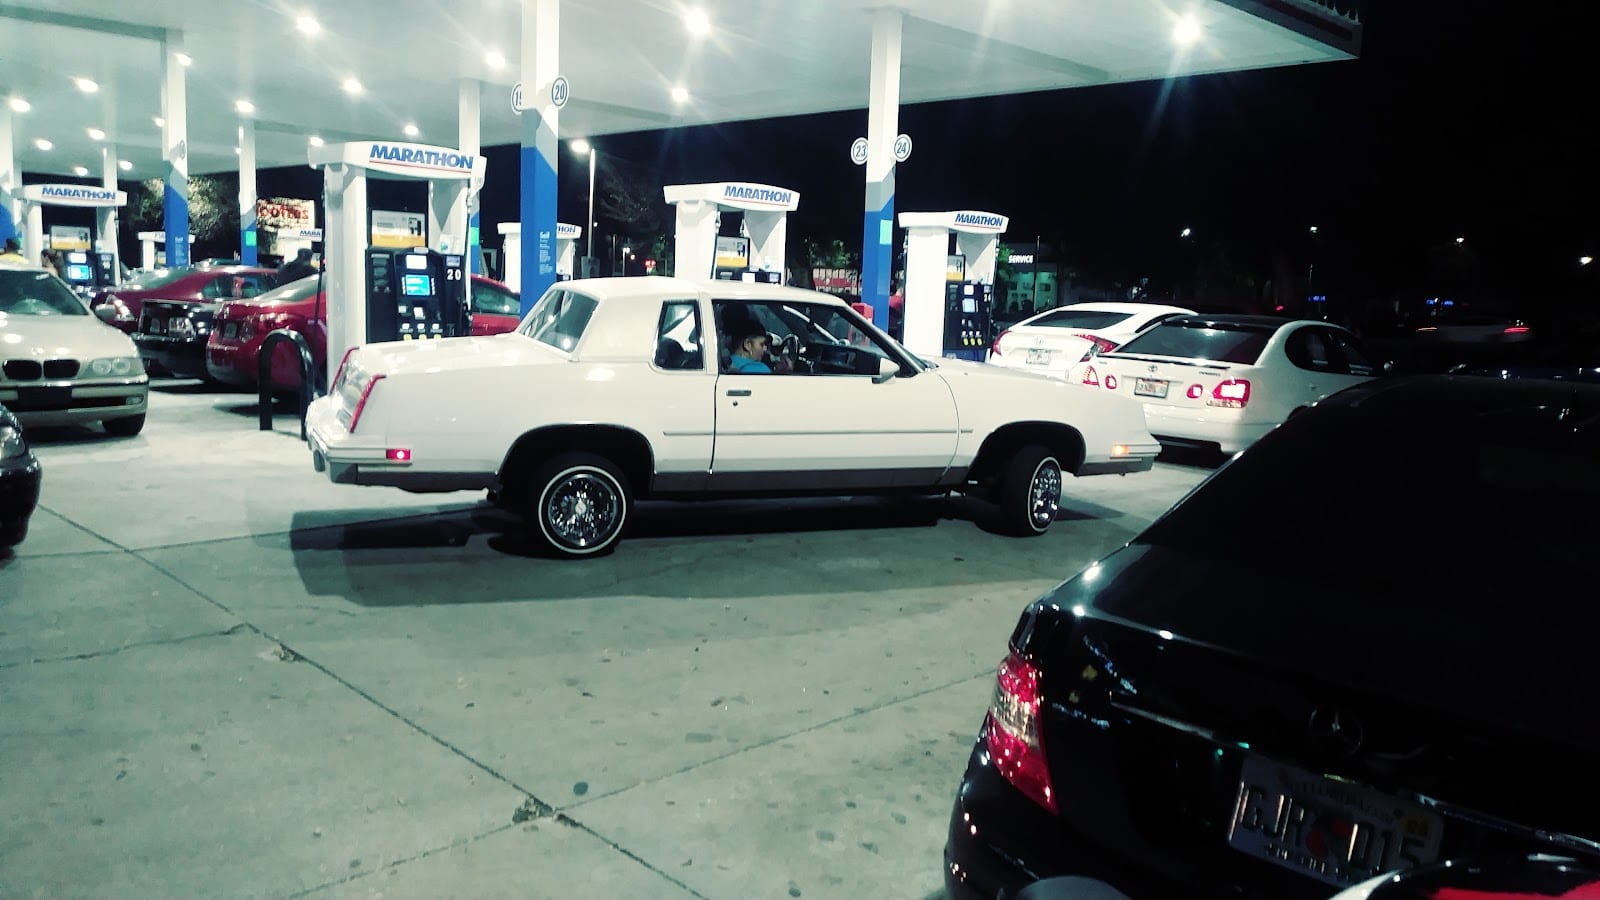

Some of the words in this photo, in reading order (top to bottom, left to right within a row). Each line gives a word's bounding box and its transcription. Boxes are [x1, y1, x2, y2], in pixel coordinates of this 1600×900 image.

[554, 83, 565, 100] 20
[856, 145, 867, 158] 23
[896, 141, 907, 154] 24
[370, 144, 474, 170] MARATHON
[42, 186, 116, 200] MARATHON
[724, 185, 792, 203] MARATHON
[955, 213, 1004, 227] MARATHON
[1008, 255, 1033, 263] SERVICE
[447, 269, 461, 281] 20
